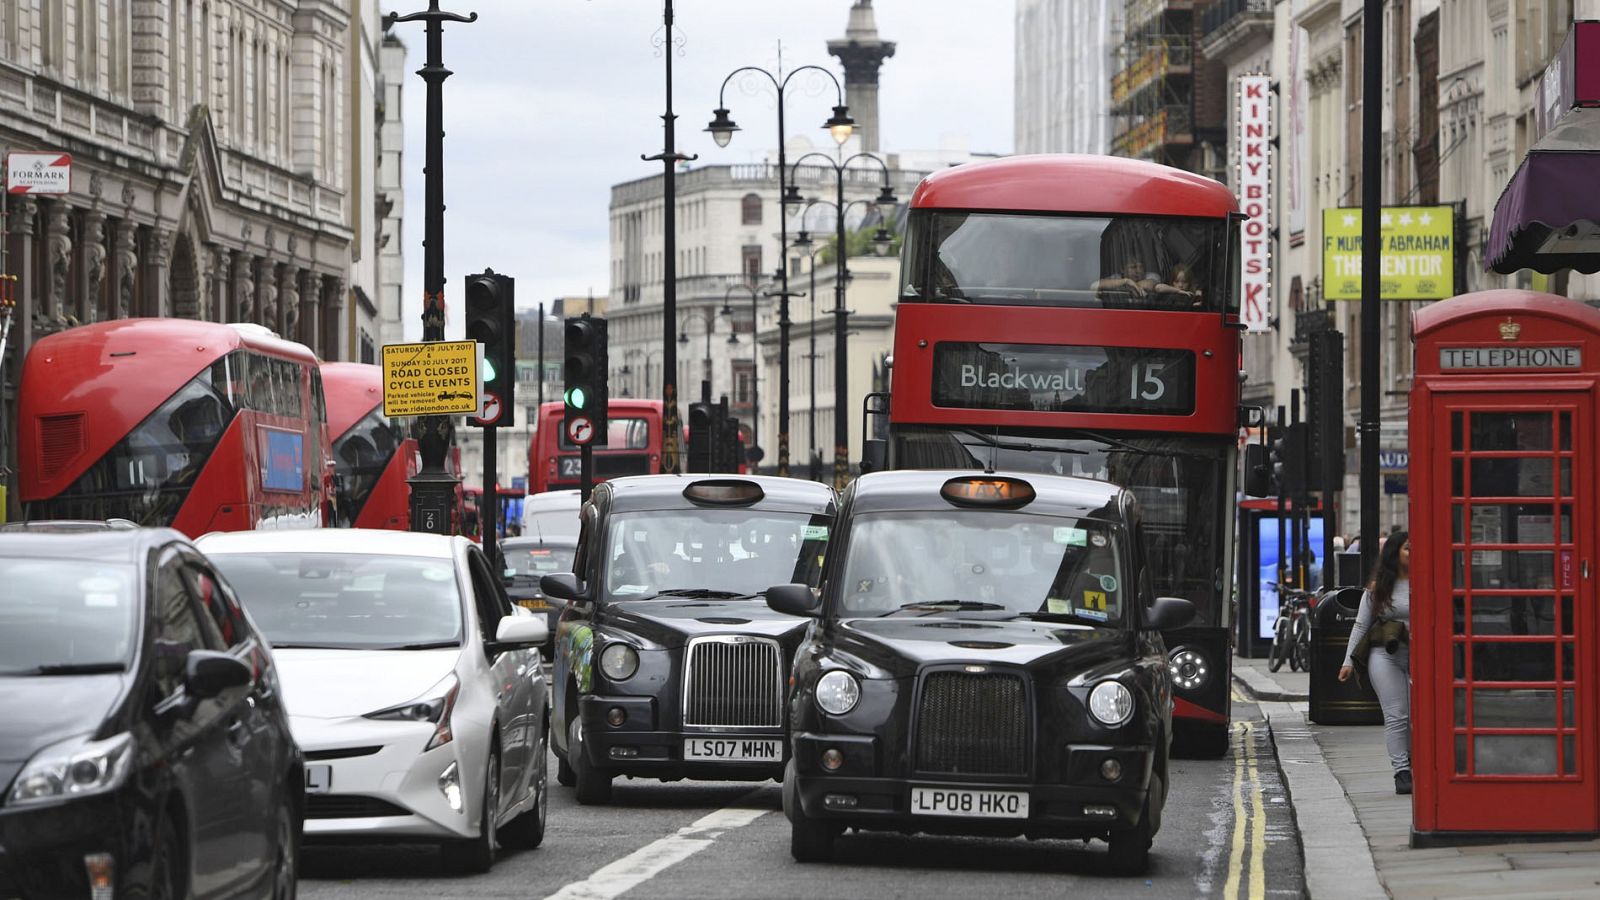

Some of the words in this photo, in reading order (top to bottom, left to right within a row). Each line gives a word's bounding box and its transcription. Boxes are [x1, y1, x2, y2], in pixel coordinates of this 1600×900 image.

[1246, 84, 1263, 176] KINKY
[13, 170, 64, 179] FORMARK
[1246, 185, 1263, 274] BOOTS
[1325, 236, 1333, 251] F
[1337, 235, 1385, 251] MURY
[1389, 234, 1450, 251] ABRAHAM
[1446, 349, 1576, 367] TELEPHONE
[391, 369, 421, 378] ROAD
[424, 366, 468, 377] CLOSED
[390, 380, 424, 390] CYCLE
[428, 378, 470, 388] EVENTS
[961, 364, 1083, 391] Blackwall
[1130, 363, 1166, 401] 15
[391, 403, 470, 413] www.ridelondon.co.uk
[129, 460, 144, 485] 11
[964, 480, 1013, 499] TAXI
[691, 740, 737, 757] LS07
[742, 741, 775, 757] MHN
[920, 791, 973, 811] LP08
[979, 793, 1019, 813] HKO
